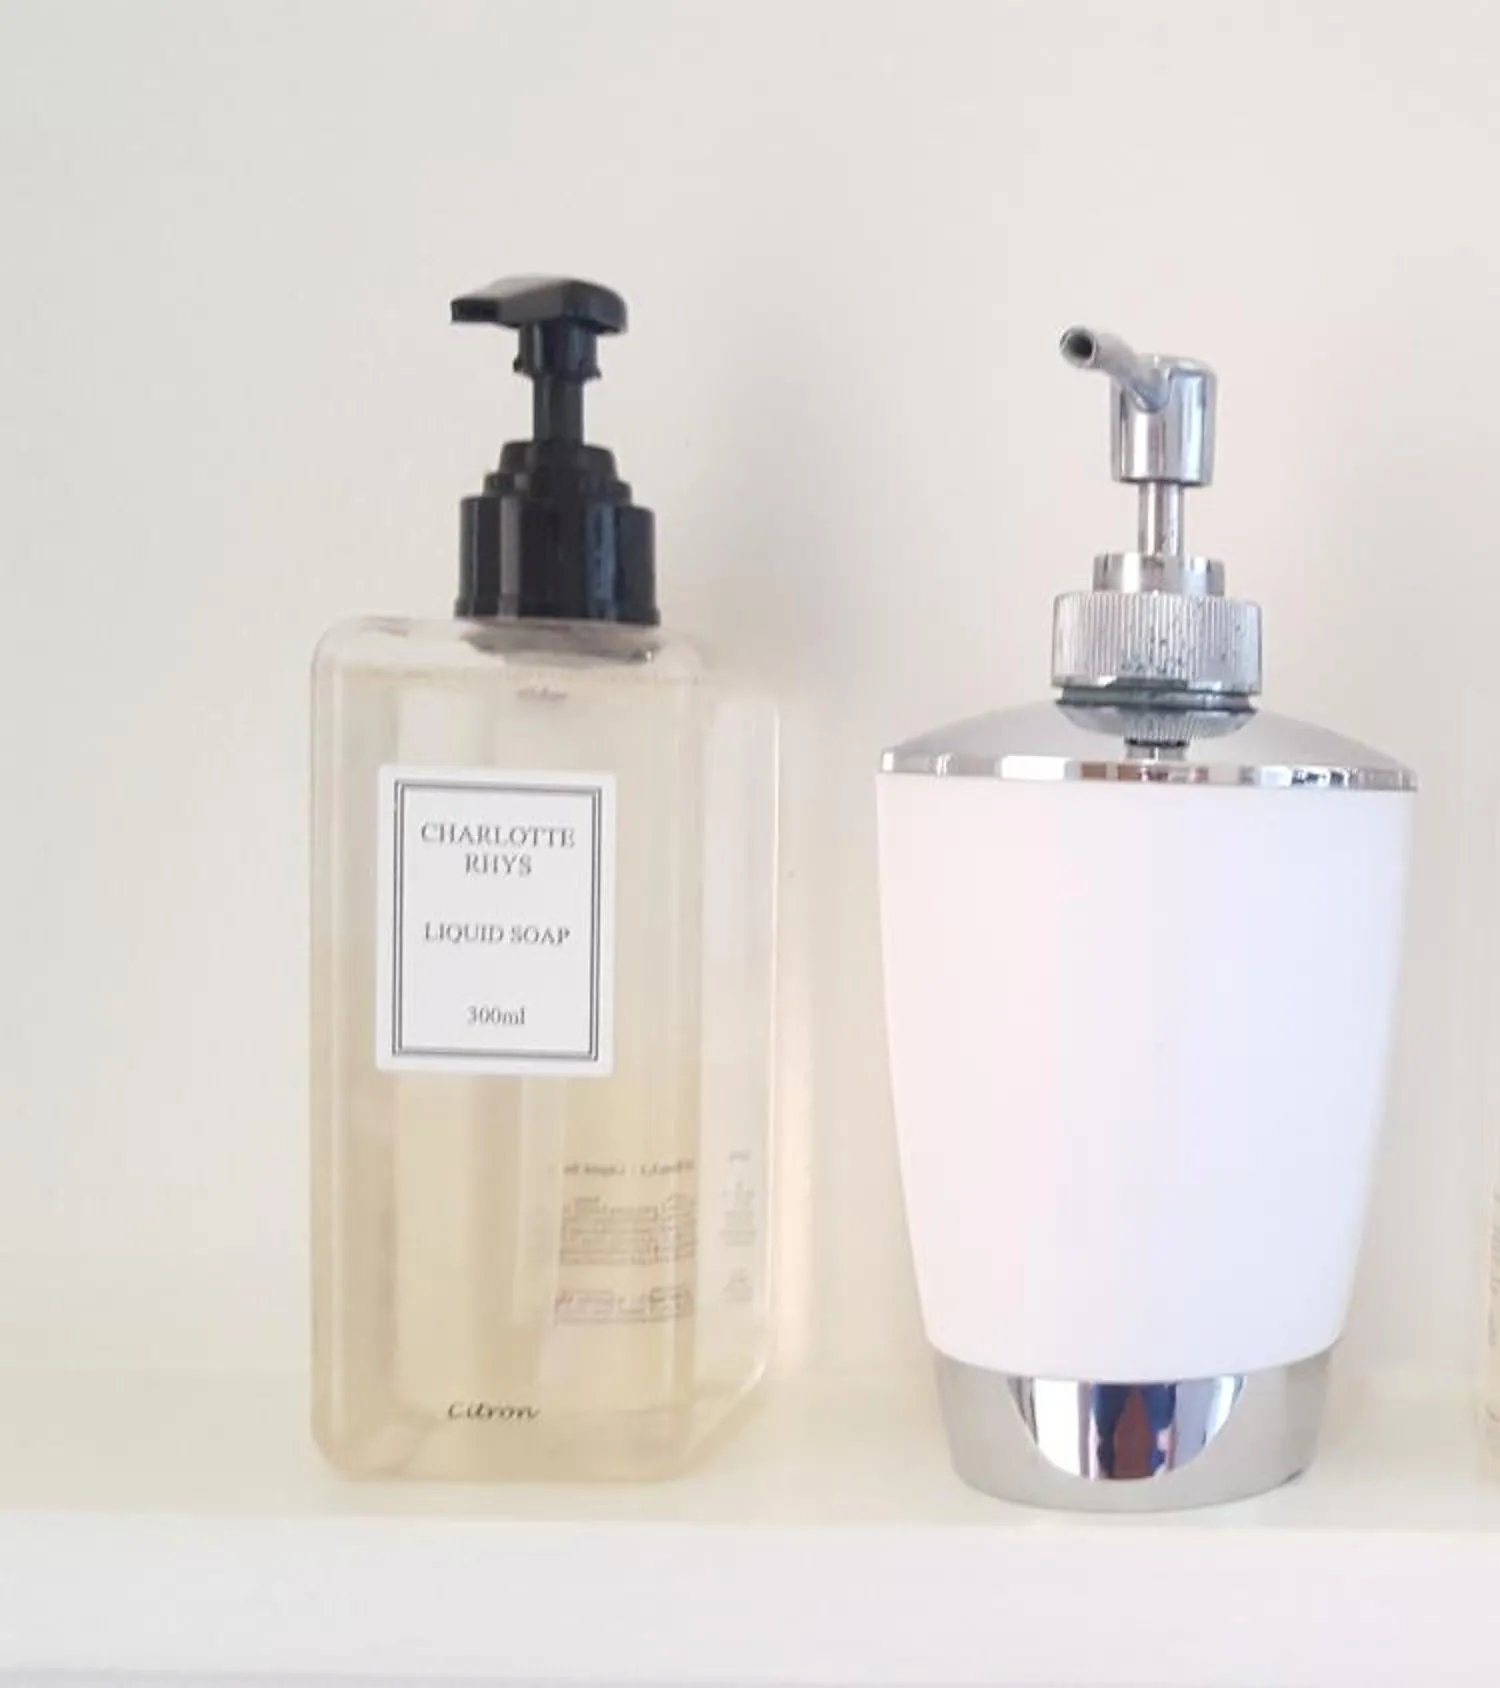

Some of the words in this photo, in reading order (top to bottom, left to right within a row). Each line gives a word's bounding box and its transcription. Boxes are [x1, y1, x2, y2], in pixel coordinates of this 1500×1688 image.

[420, 821, 577, 849] CHARLOTTE
[464, 853, 533, 876] RHYS
[424, 922, 504, 945] LIQUID
[510, 925, 571, 946] SOAP
[466, 1005, 526, 1026] 300ml
[447, 1401, 540, 1421] Citron
